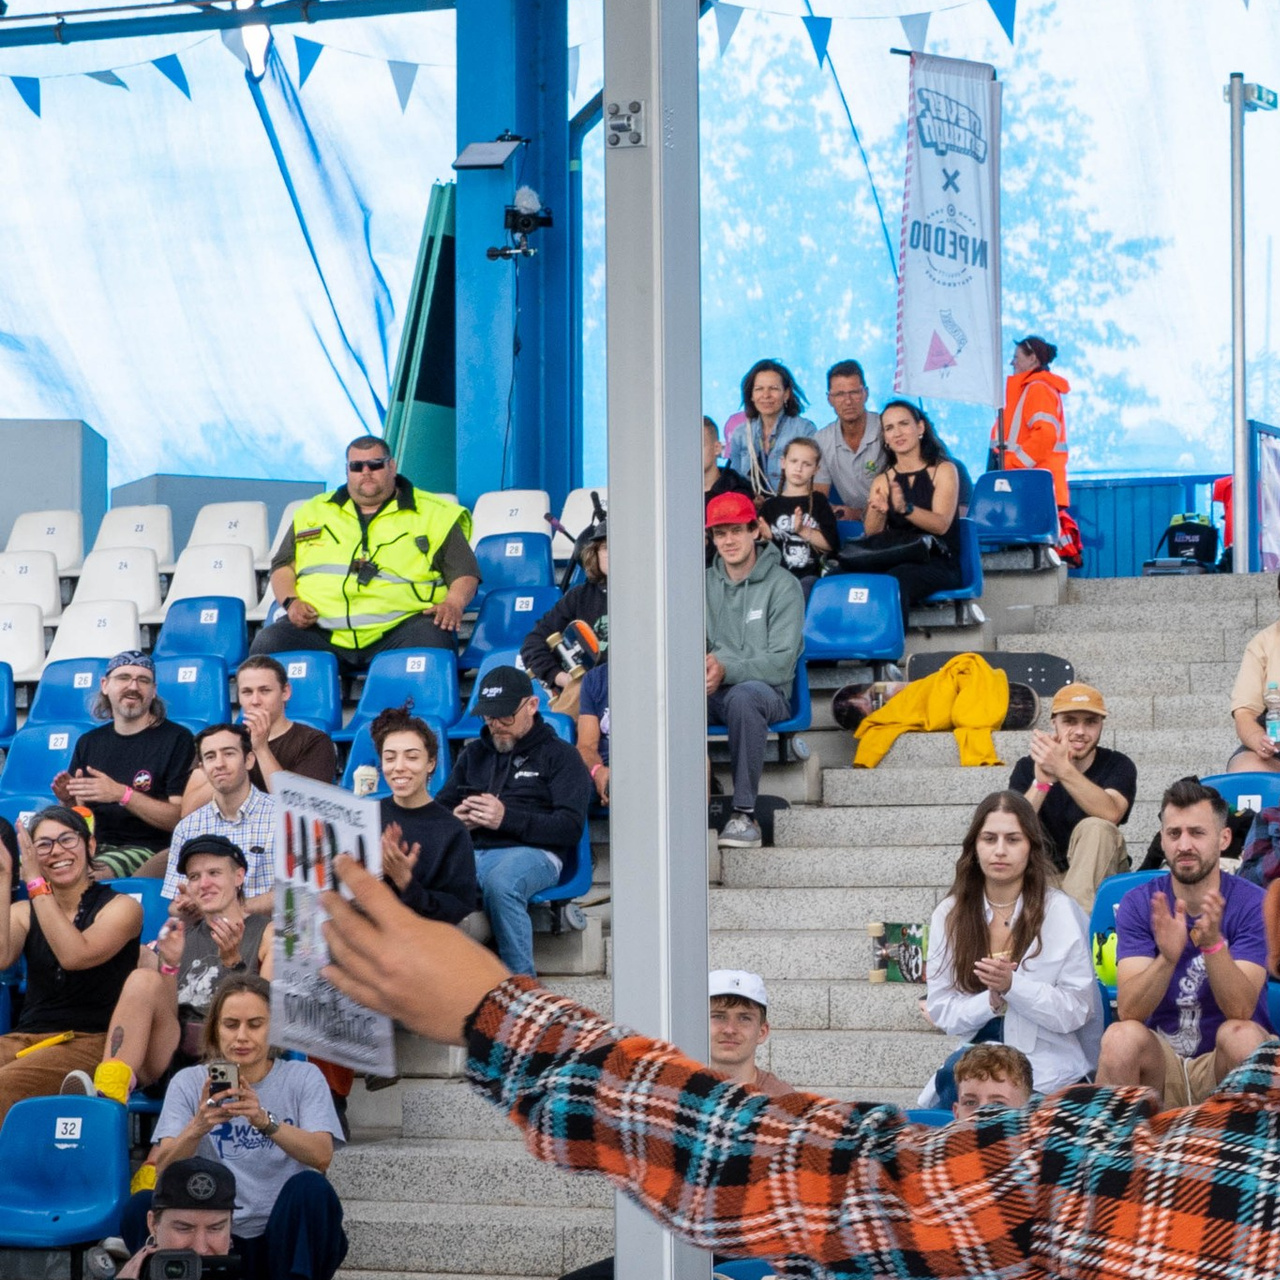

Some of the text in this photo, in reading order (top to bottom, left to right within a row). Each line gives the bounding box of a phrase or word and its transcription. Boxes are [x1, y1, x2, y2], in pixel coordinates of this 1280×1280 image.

[853, 591, 865, 601] 32
[518, 600, 530, 609] 29
[410, 660, 422, 670] 29
[181, 670, 193, 680] 27
[291, 666, 303, 676] 28
[77, 676, 89, 686] 26
[53, 736, 65, 747] 27
[61, 1122, 77, 1136] 32
